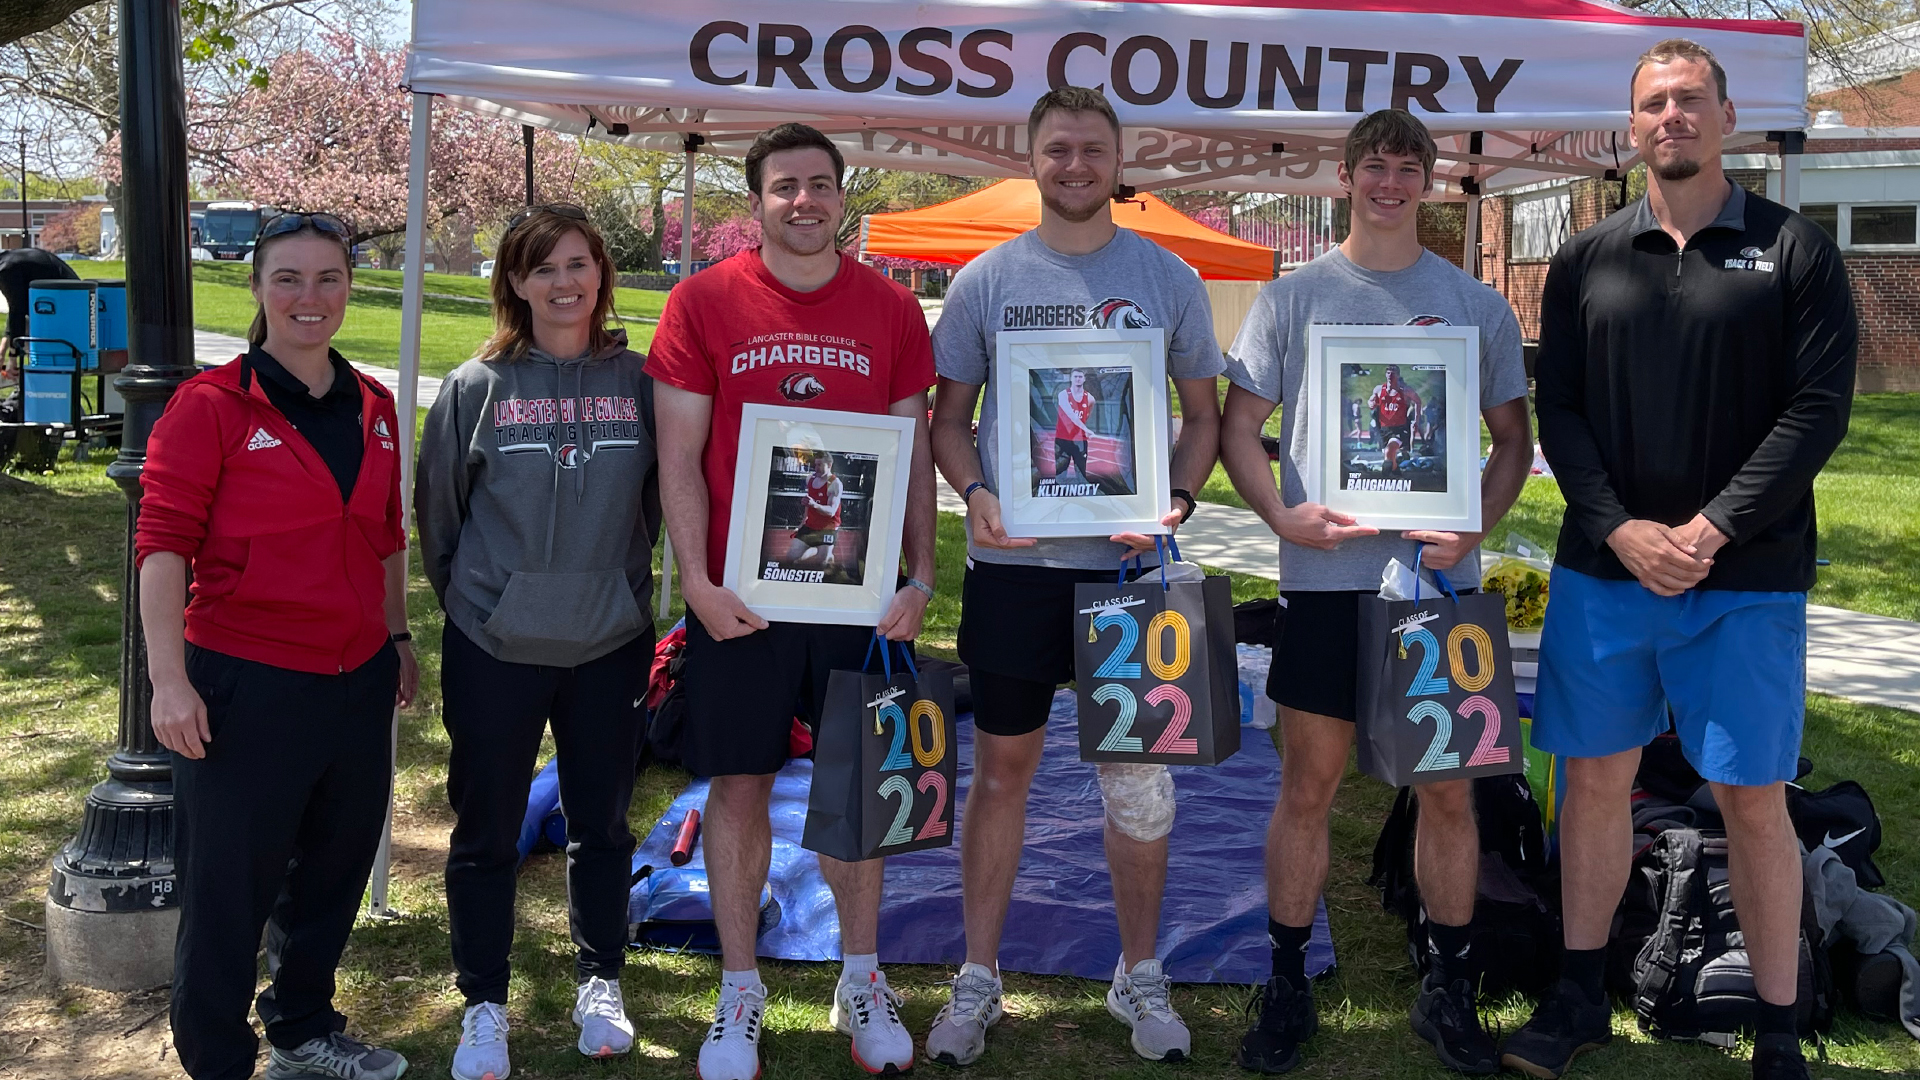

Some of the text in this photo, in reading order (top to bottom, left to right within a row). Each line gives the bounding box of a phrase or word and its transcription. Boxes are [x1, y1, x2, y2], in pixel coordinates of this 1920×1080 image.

[689, 20, 1525, 113] CROSS COUNTRY
[1724, 258, 1748, 269] TRACK
[1754, 260, 1775, 273] FIELD
[1003, 304, 1086, 328] CHARGERS
[747, 332, 857, 348] LANCASTER BIBLE COLLEGE
[731, 344, 870, 377] CHARGERS
[493, 398, 558, 428] LANCASTER
[595, 396, 639, 422] COLLEGE
[247, 438, 282, 451] adidas
[494, 425, 558, 445] TRACK
[589, 423, 640, 439] FIELD
[1037, 483, 1100, 497] KLUTINOTY
[1346, 478, 1412, 492] BAUGHMAN
[763, 568, 825, 583] SONGSTER
[1092, 594, 1134, 609] CLASS OF
[1398, 610, 1429, 626] CLASS OF
[1092, 609, 1191, 681] 20
[1402, 622, 1496, 698] 20
[1091, 683, 1199, 755] 22
[878, 699, 947, 772] 20
[1406, 695, 1510, 773] 22
[877, 770, 948, 849] 22
[151, 880, 173, 894] H8
